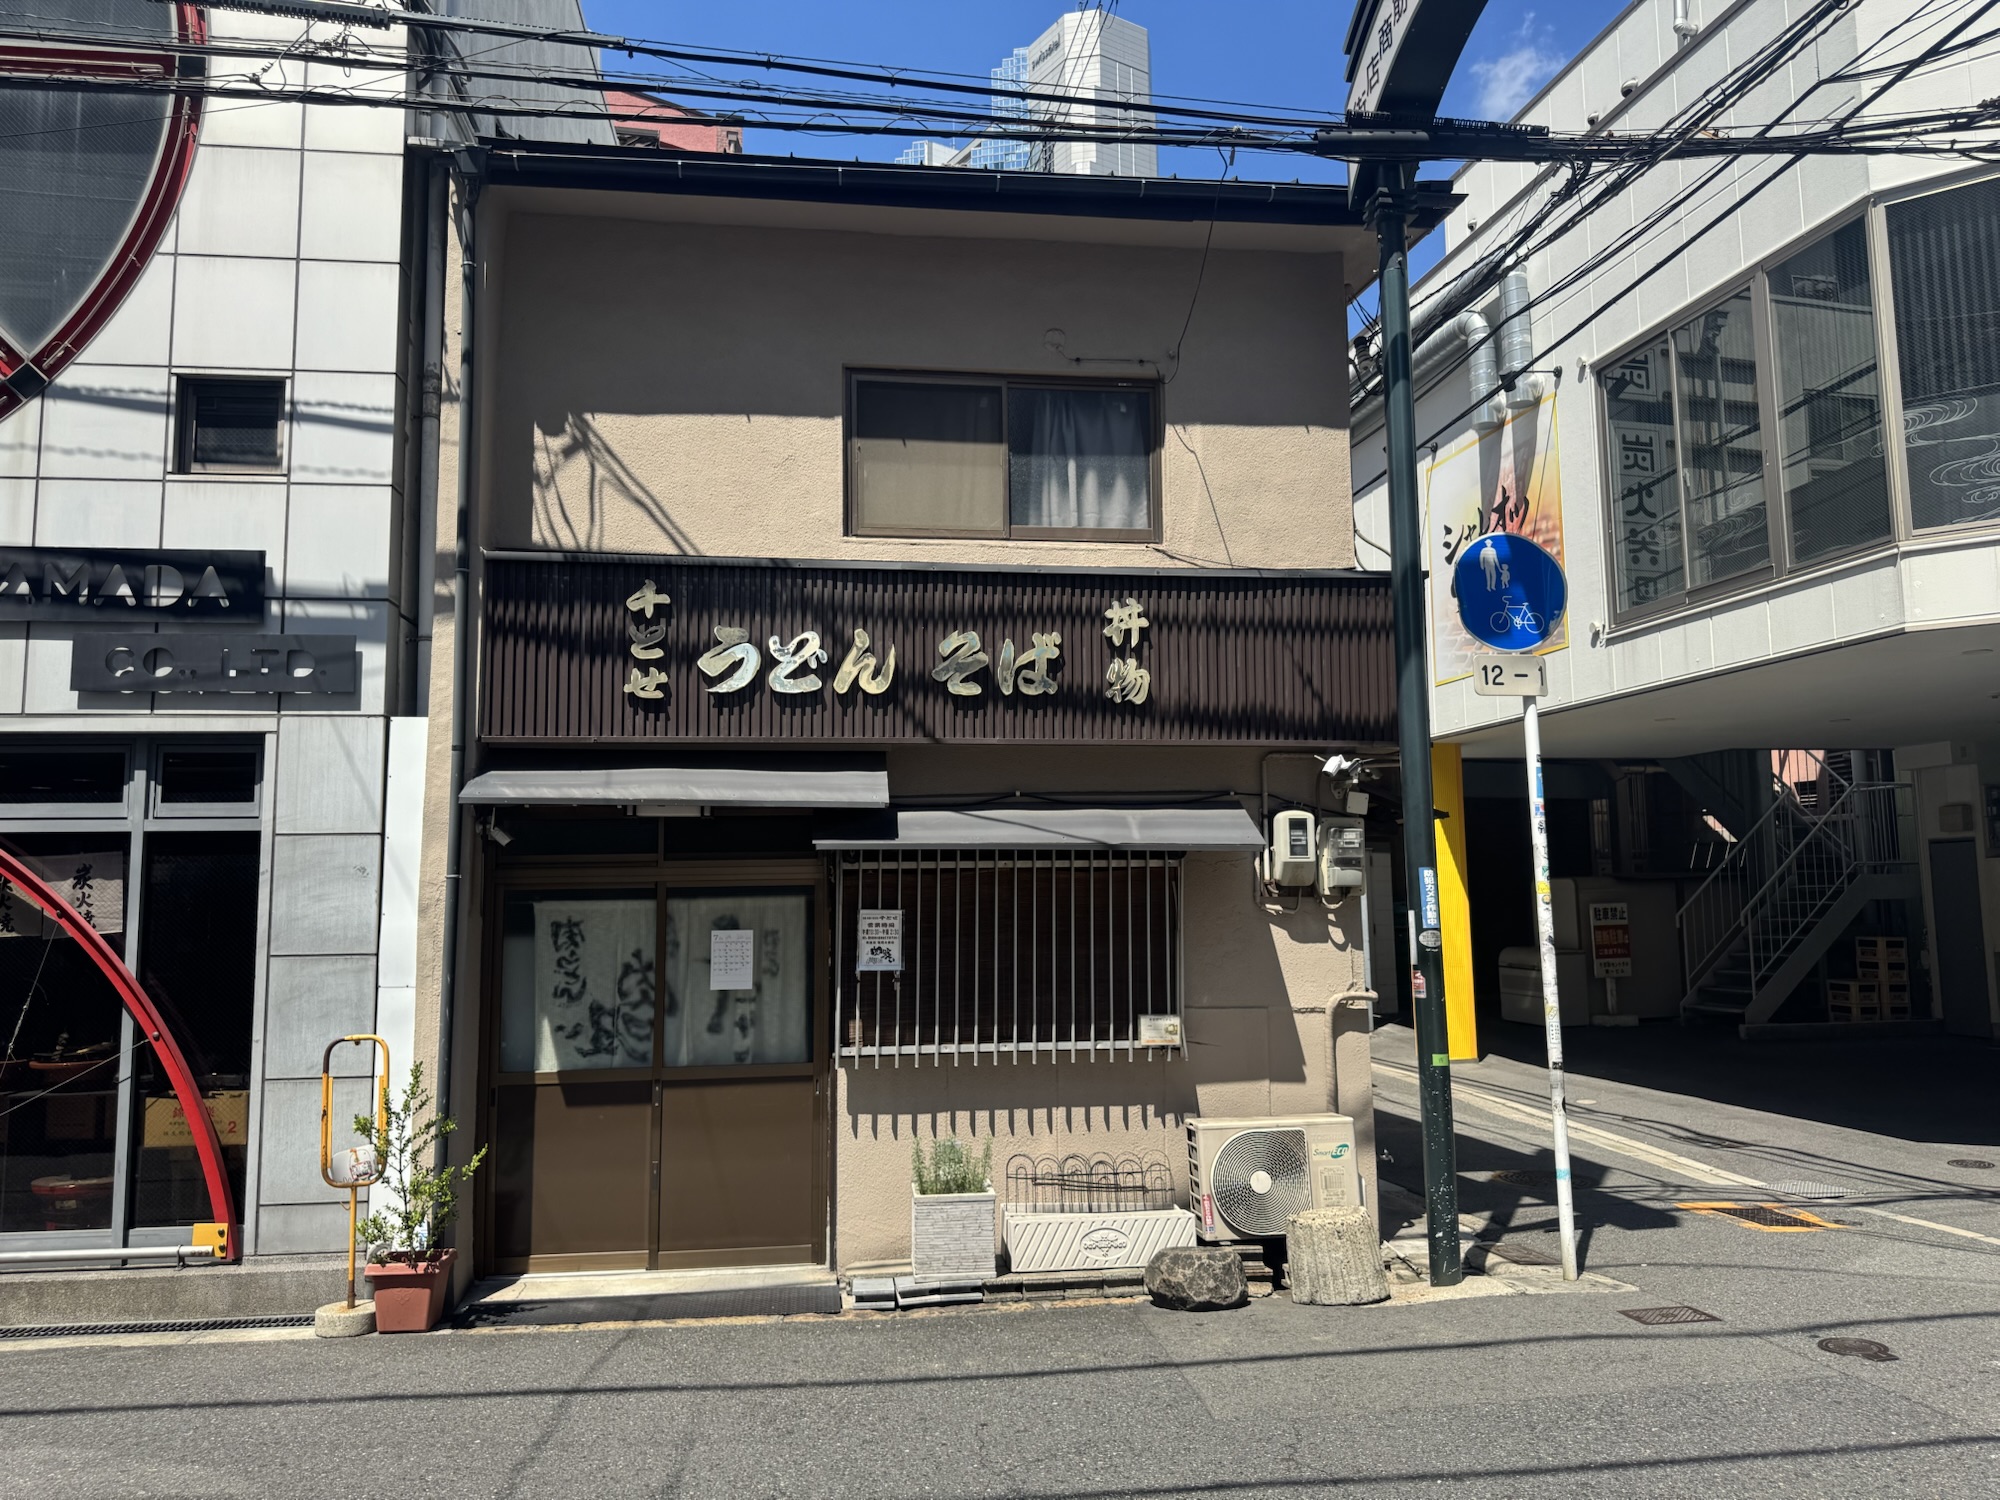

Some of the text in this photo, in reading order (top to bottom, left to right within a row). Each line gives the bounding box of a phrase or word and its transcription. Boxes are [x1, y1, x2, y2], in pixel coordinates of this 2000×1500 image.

[0, 562, 230, 608] AMADA
[623, 579, 671, 699] 千とせ
[221, 648, 326, 679] LTD.
[697, 625, 1062, 696] うどん そば
[1594, 907, 1627, 921] 駐車禁止
[227, 1121, 237, 1134] 2
